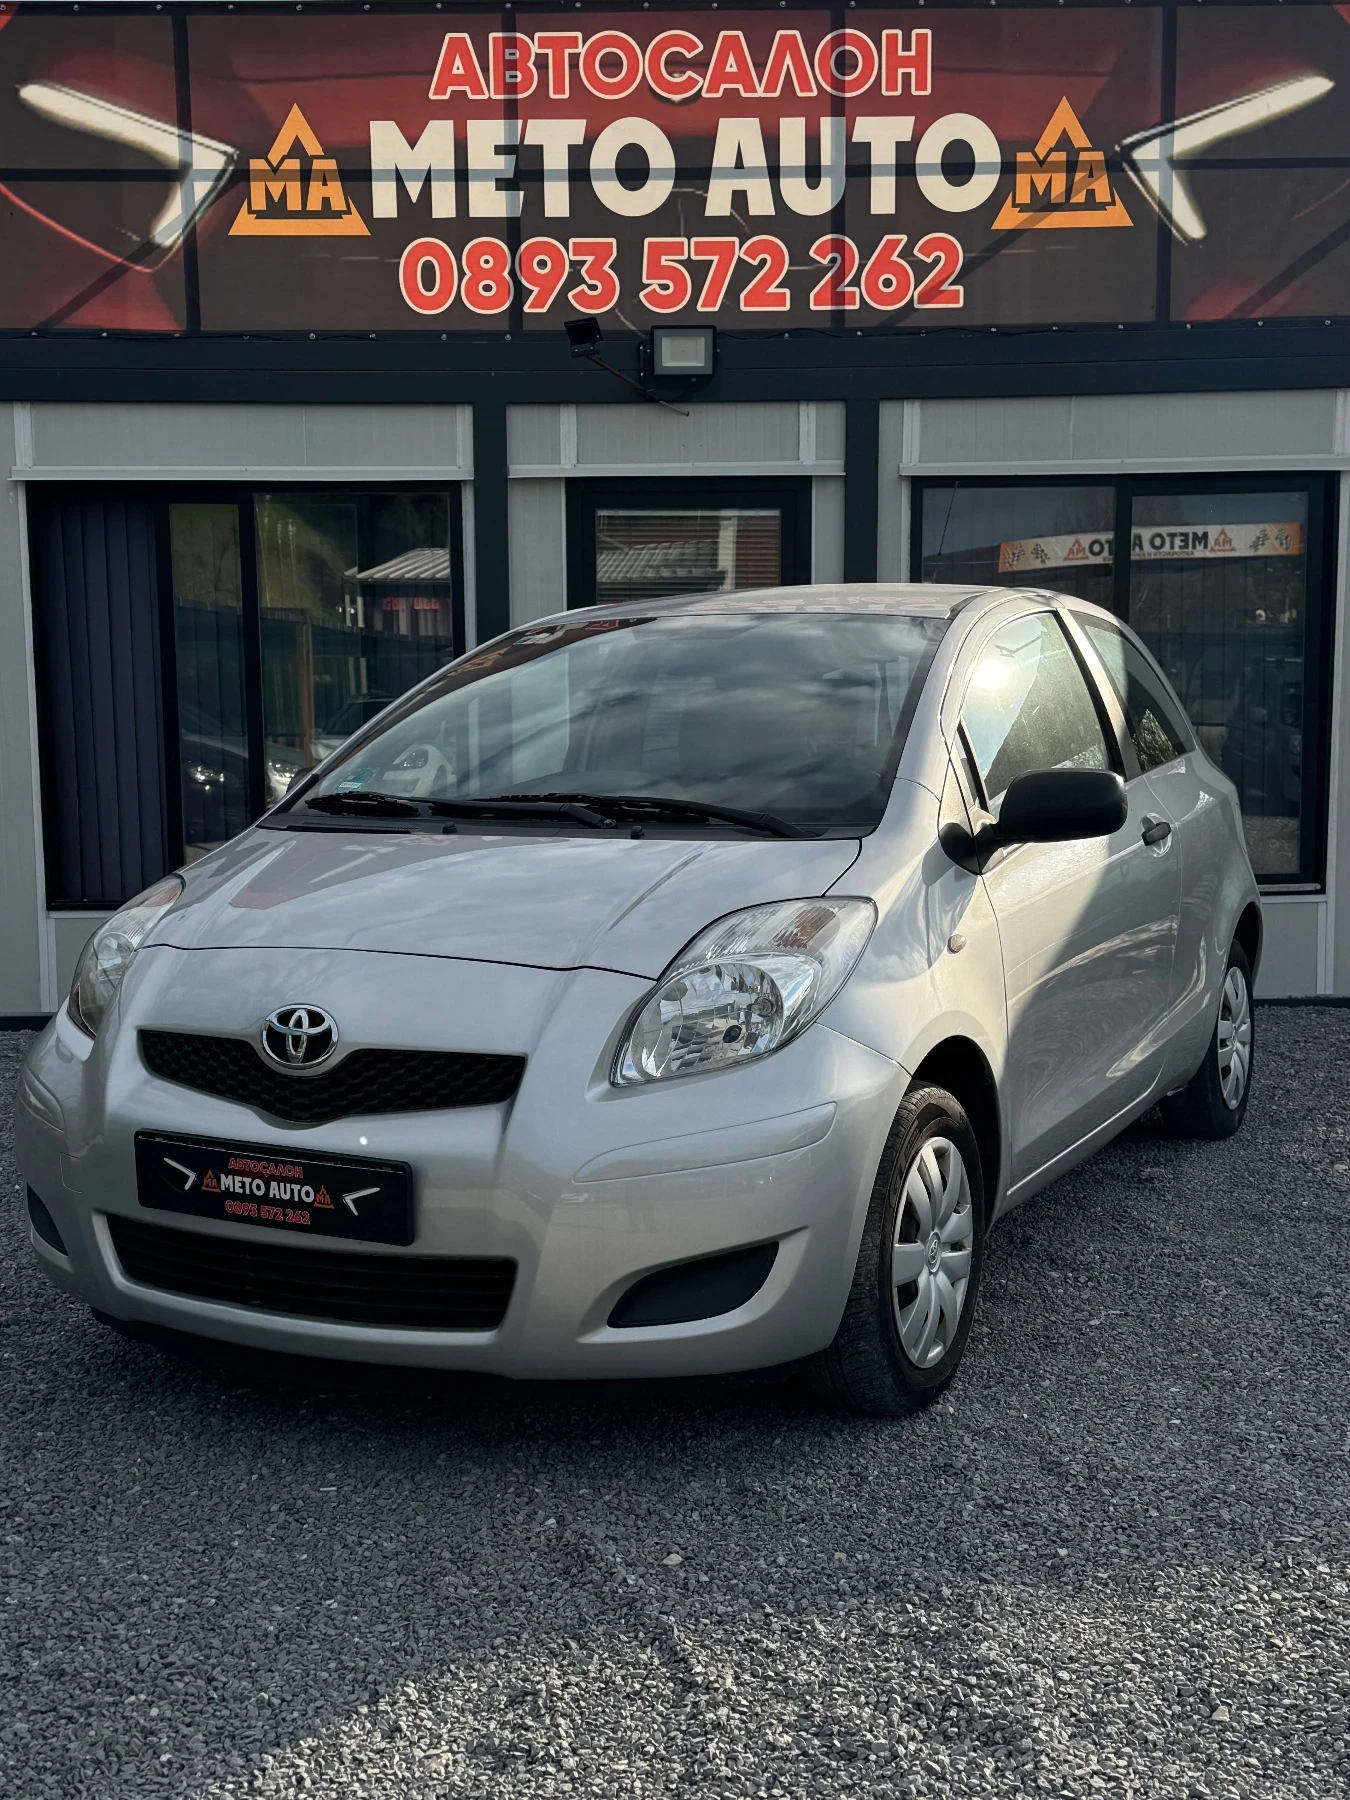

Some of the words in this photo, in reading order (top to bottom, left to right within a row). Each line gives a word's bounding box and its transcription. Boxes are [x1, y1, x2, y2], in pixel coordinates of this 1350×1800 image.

[429, 28, 932, 100] АВТОСАЛОН
[249, 157, 348, 211] MA
[369, 116, 675, 218] METO
[704, 113, 1001, 217] AUTO
[1015, 151, 1113, 204] MA
[398, 237, 620, 315] 0893
[639, 235, 791, 313] 572
[809, 232, 964, 311] 262
[220, 1173, 266, 1197] METO
[269, 1181, 315, 1203] AUTO
[228, 1157, 304, 1179] АВТОСАЛОН
[224, 1200, 258, 1217] 0893
[260, 1205, 284, 1221] 572
[285, 1209, 311, 1225] 262
